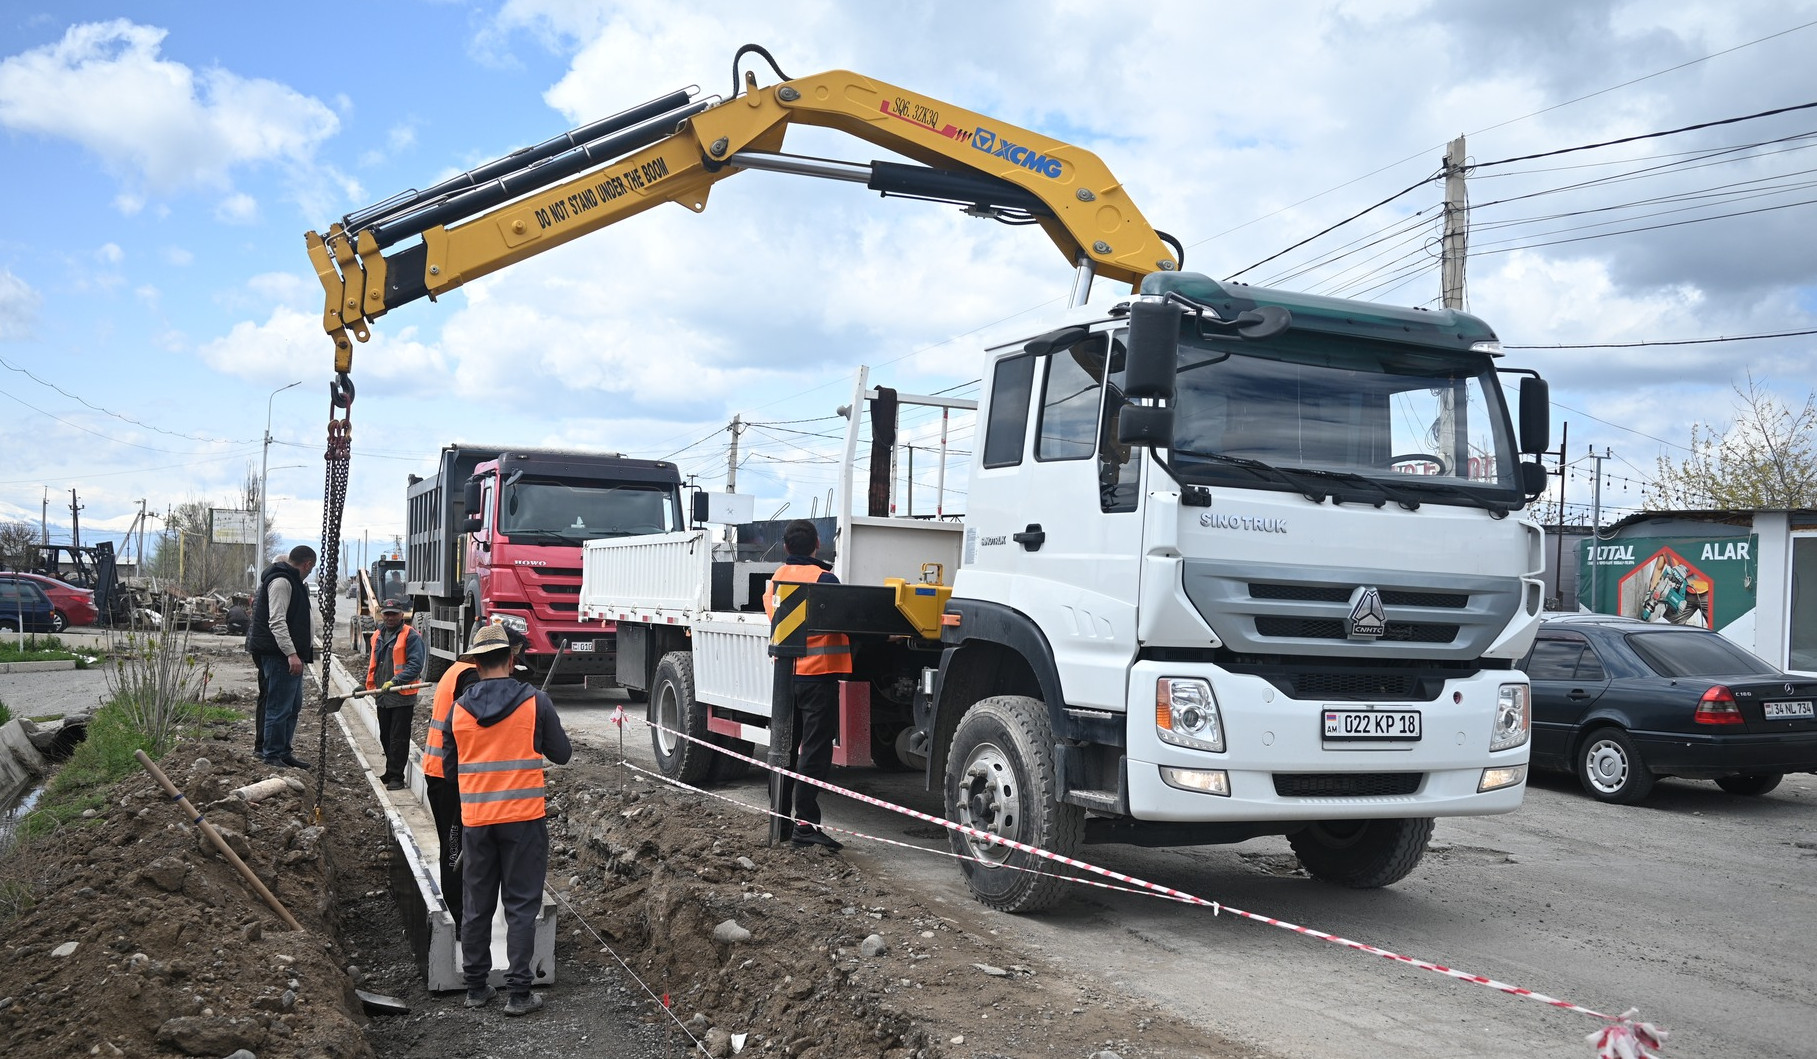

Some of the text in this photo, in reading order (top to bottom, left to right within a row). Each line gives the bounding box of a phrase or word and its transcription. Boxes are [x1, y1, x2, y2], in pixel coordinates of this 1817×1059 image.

[991, 138, 1063, 179] XCMG
[534, 156, 670, 229] DO NOT STAND UNDER THE BOOM
[1200, 512, 1287, 533] SINOTRUK
[1701, 542, 1750, 561] ALAR
[1355, 626, 1383, 634] CNHTC
[1774, 702, 1812, 715] 34 NL 734
[1327, 725, 1337, 733] AM
[1344, 714, 1416, 734] 022 KP 18
